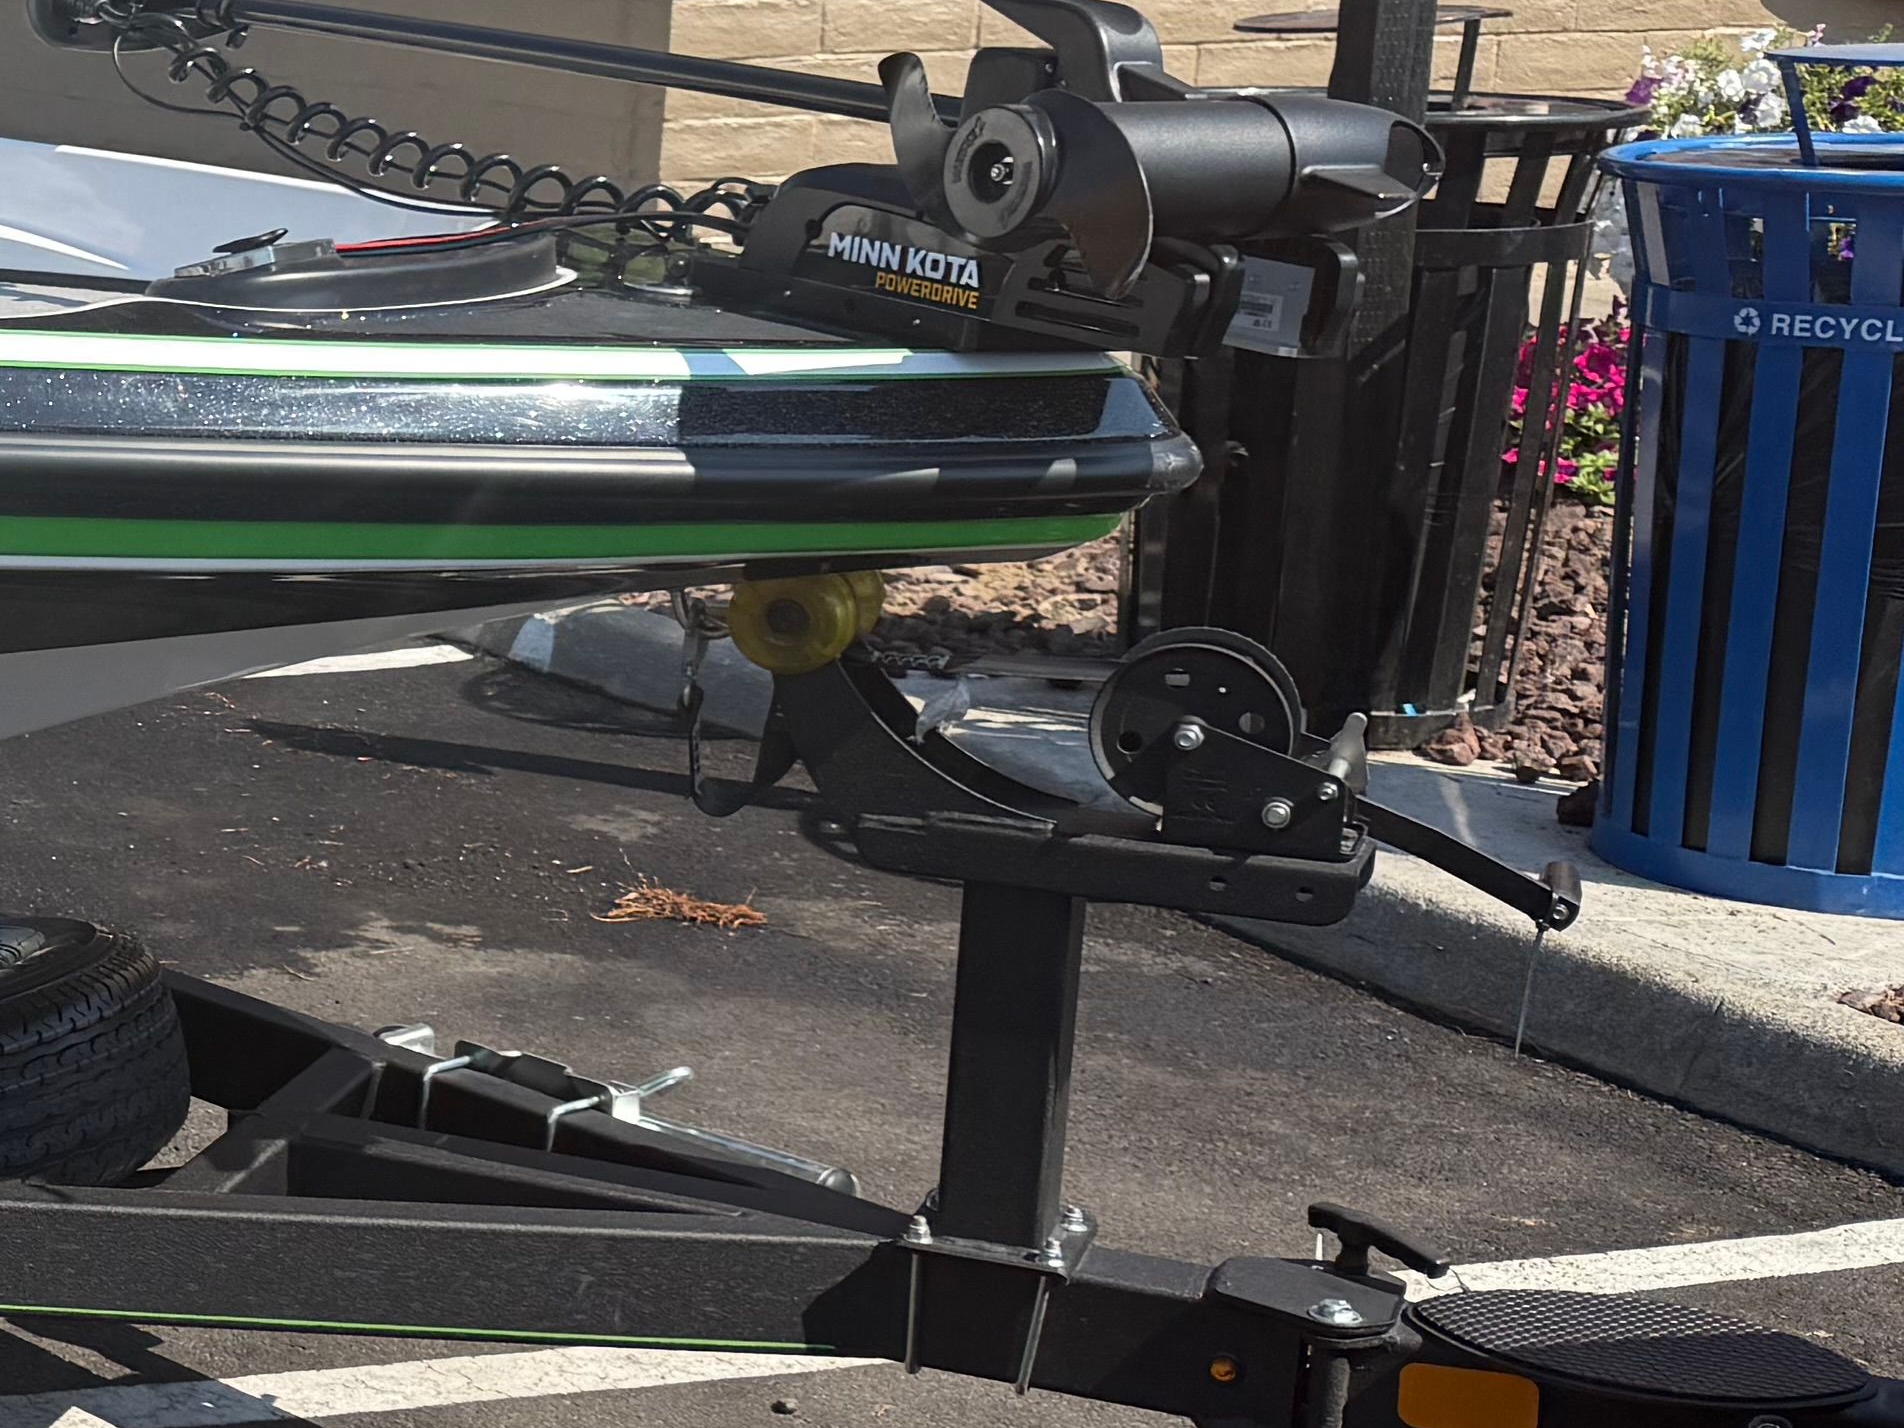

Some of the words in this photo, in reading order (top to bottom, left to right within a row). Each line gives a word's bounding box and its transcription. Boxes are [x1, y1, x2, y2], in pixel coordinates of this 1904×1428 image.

[827, 231, 902, 271] MINN
[905, 247, 980, 288] KOTA
[875, 271, 980, 310] POWERDRIVE
[1770, 313, 1904, 343] RECYCL
